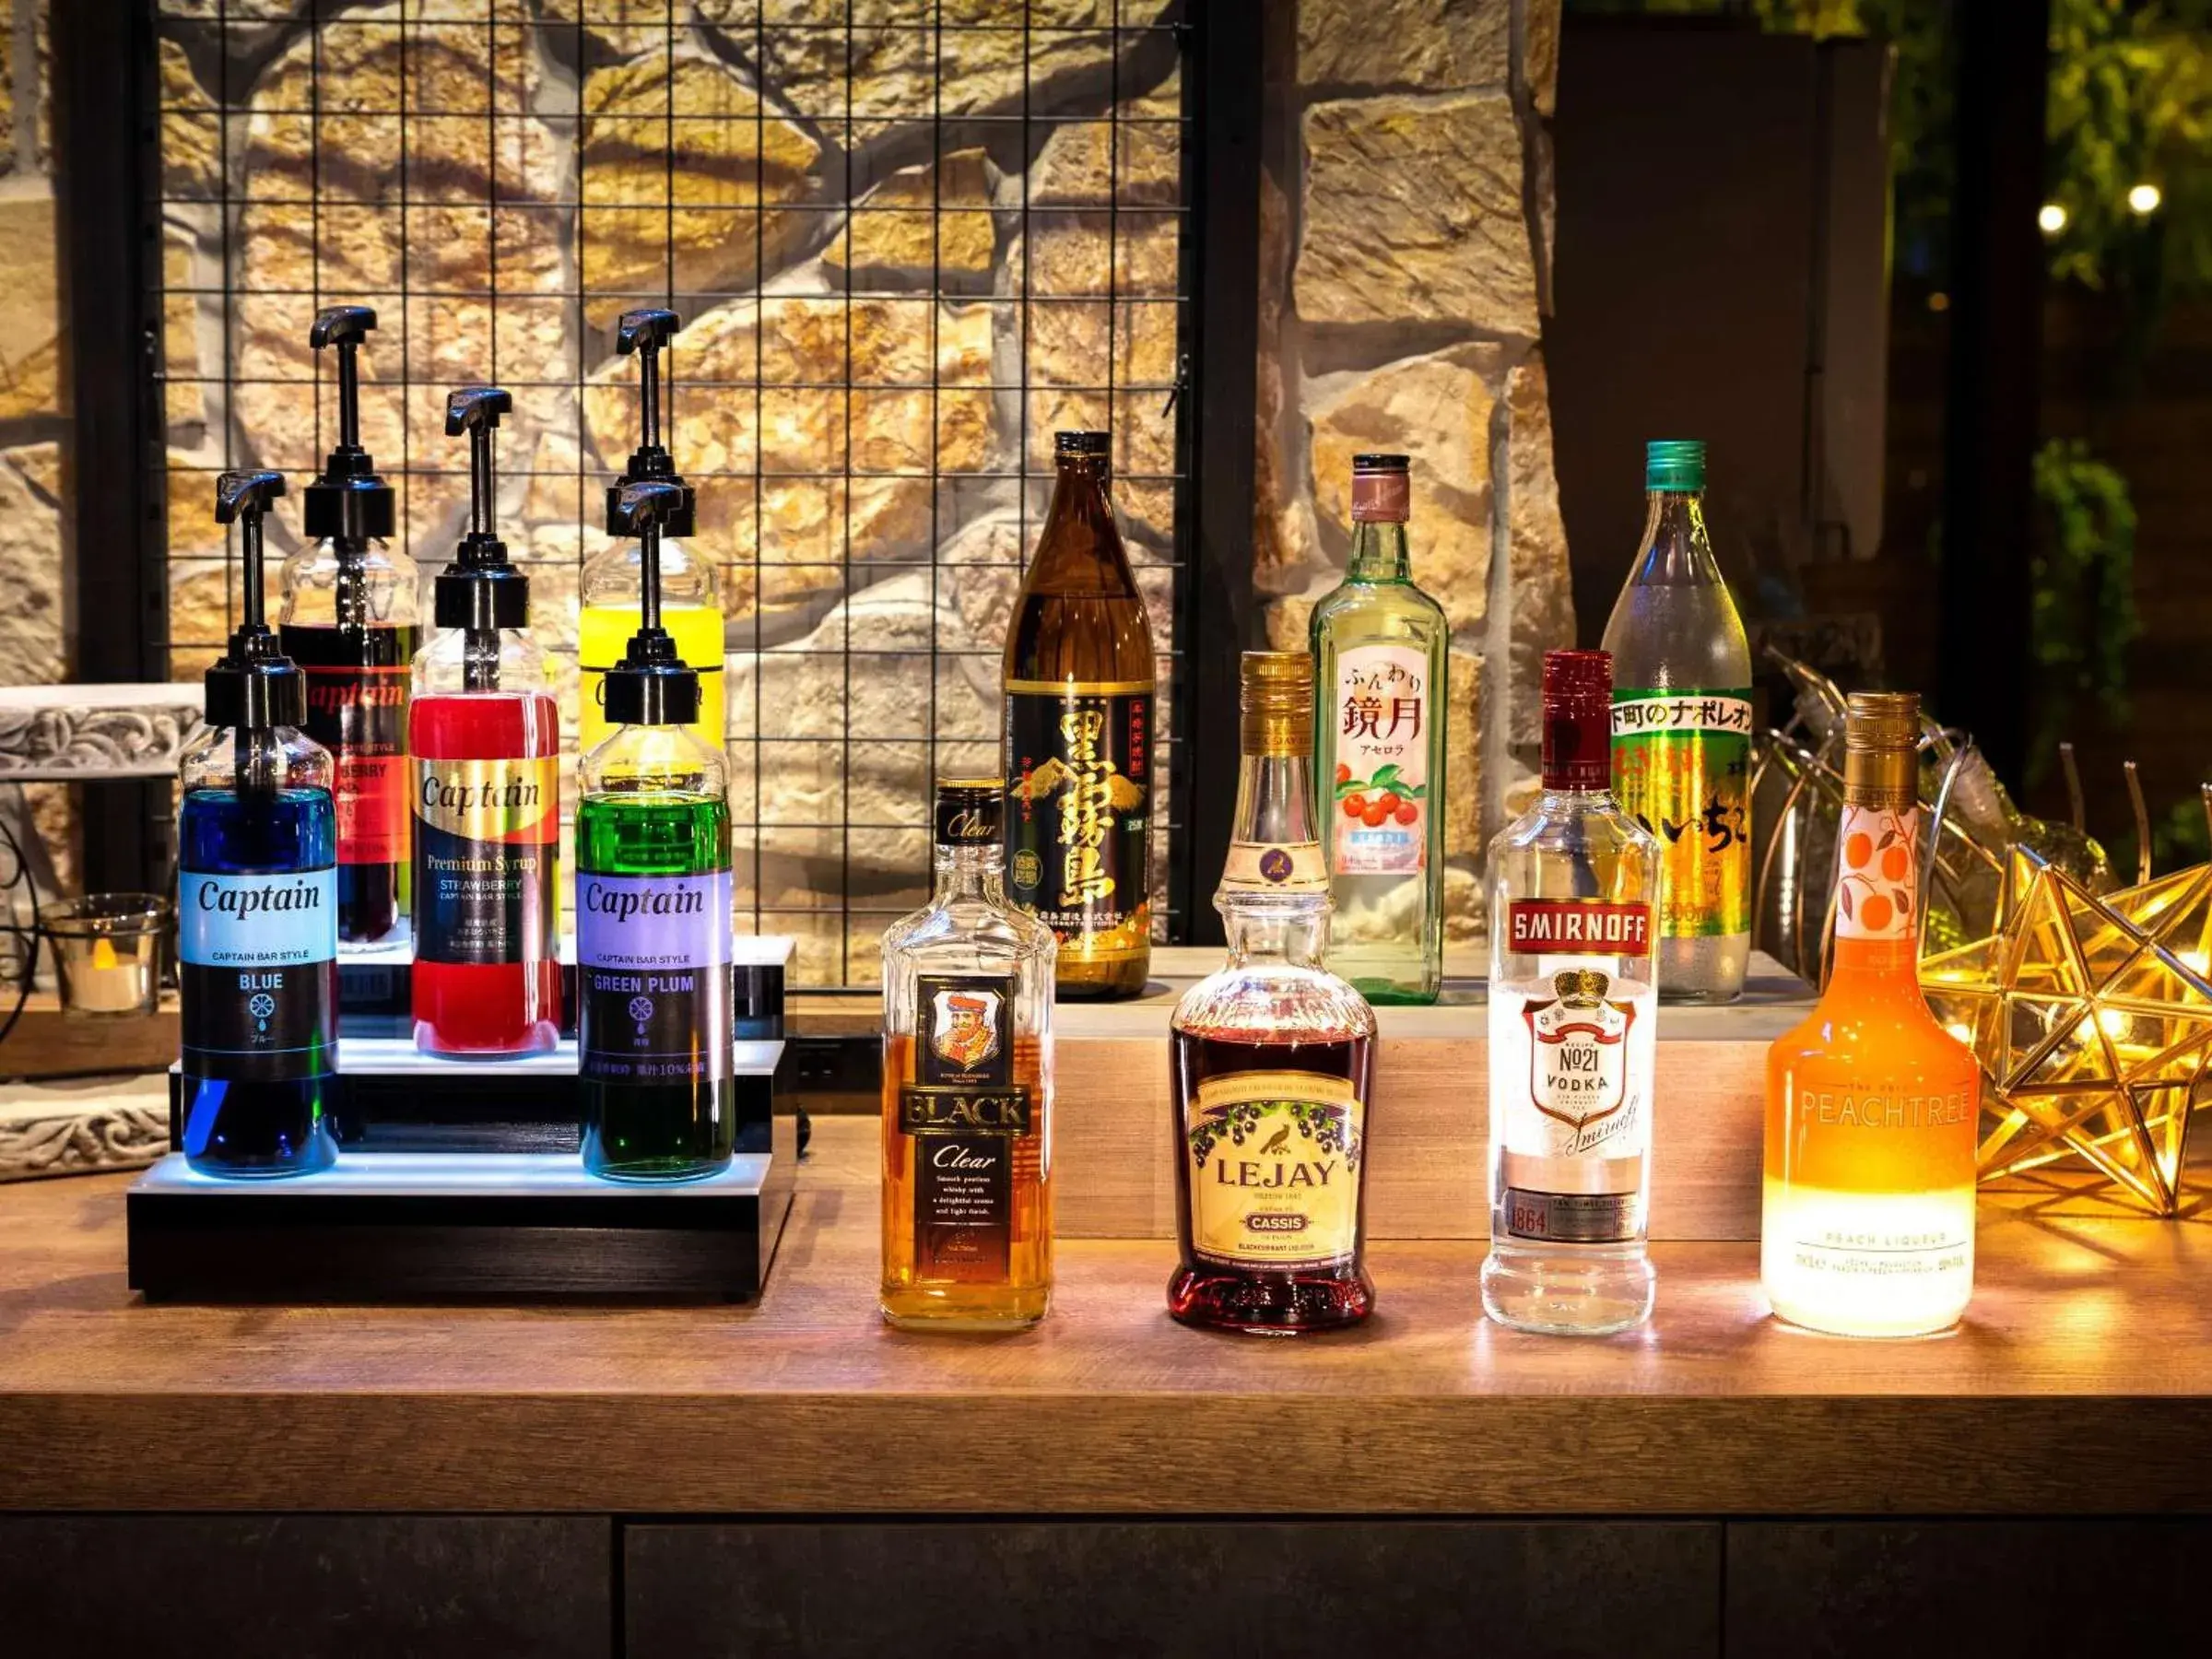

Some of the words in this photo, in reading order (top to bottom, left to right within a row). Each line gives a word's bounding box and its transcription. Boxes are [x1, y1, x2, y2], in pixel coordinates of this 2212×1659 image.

[1345, 664, 1421, 693] ふんわり
[308, 678, 404, 713] aptain
[1342, 697, 1422, 742] 鏡月
[1359, 744, 1405, 756] アセロラ
[422, 776, 539, 817] Captain
[947, 812, 996, 838] Clear
[427, 854, 493, 872] Premium
[494, 854, 537, 876] Syrup
[440, 879, 524, 891] STRAWBERRY
[198, 879, 320, 921] Captain
[586, 882, 704, 923] Captain
[1514, 912, 1646, 944] SMIRNOFF
[212, 951, 256, 962] CAPTAIN
[256, 952, 278, 961] BAR
[279, 949, 310, 960] STYLE
[596, 953, 635, 964] CAPTAIN
[636, 955, 658, 964] BAR
[659, 953, 691, 964] STYLE
[239, 973, 283, 990] BLUE
[594, 974, 642, 993] GREEN
[648, 975, 695, 993] PLUM
[1547, 1074, 1609, 1091] VODKA
[905, 1095, 1028, 1125] BLACK
[1801, 1089, 1971, 1129] PEACHTREE
[933, 1144, 996, 1169] Clear
[1217, 1159, 1337, 1188] LEJAY
[1252, 1218, 1302, 1230] CASSIS
[1512, 1207, 1547, 1233] 1864
[1825, 1232, 1877, 1245] PEACH
